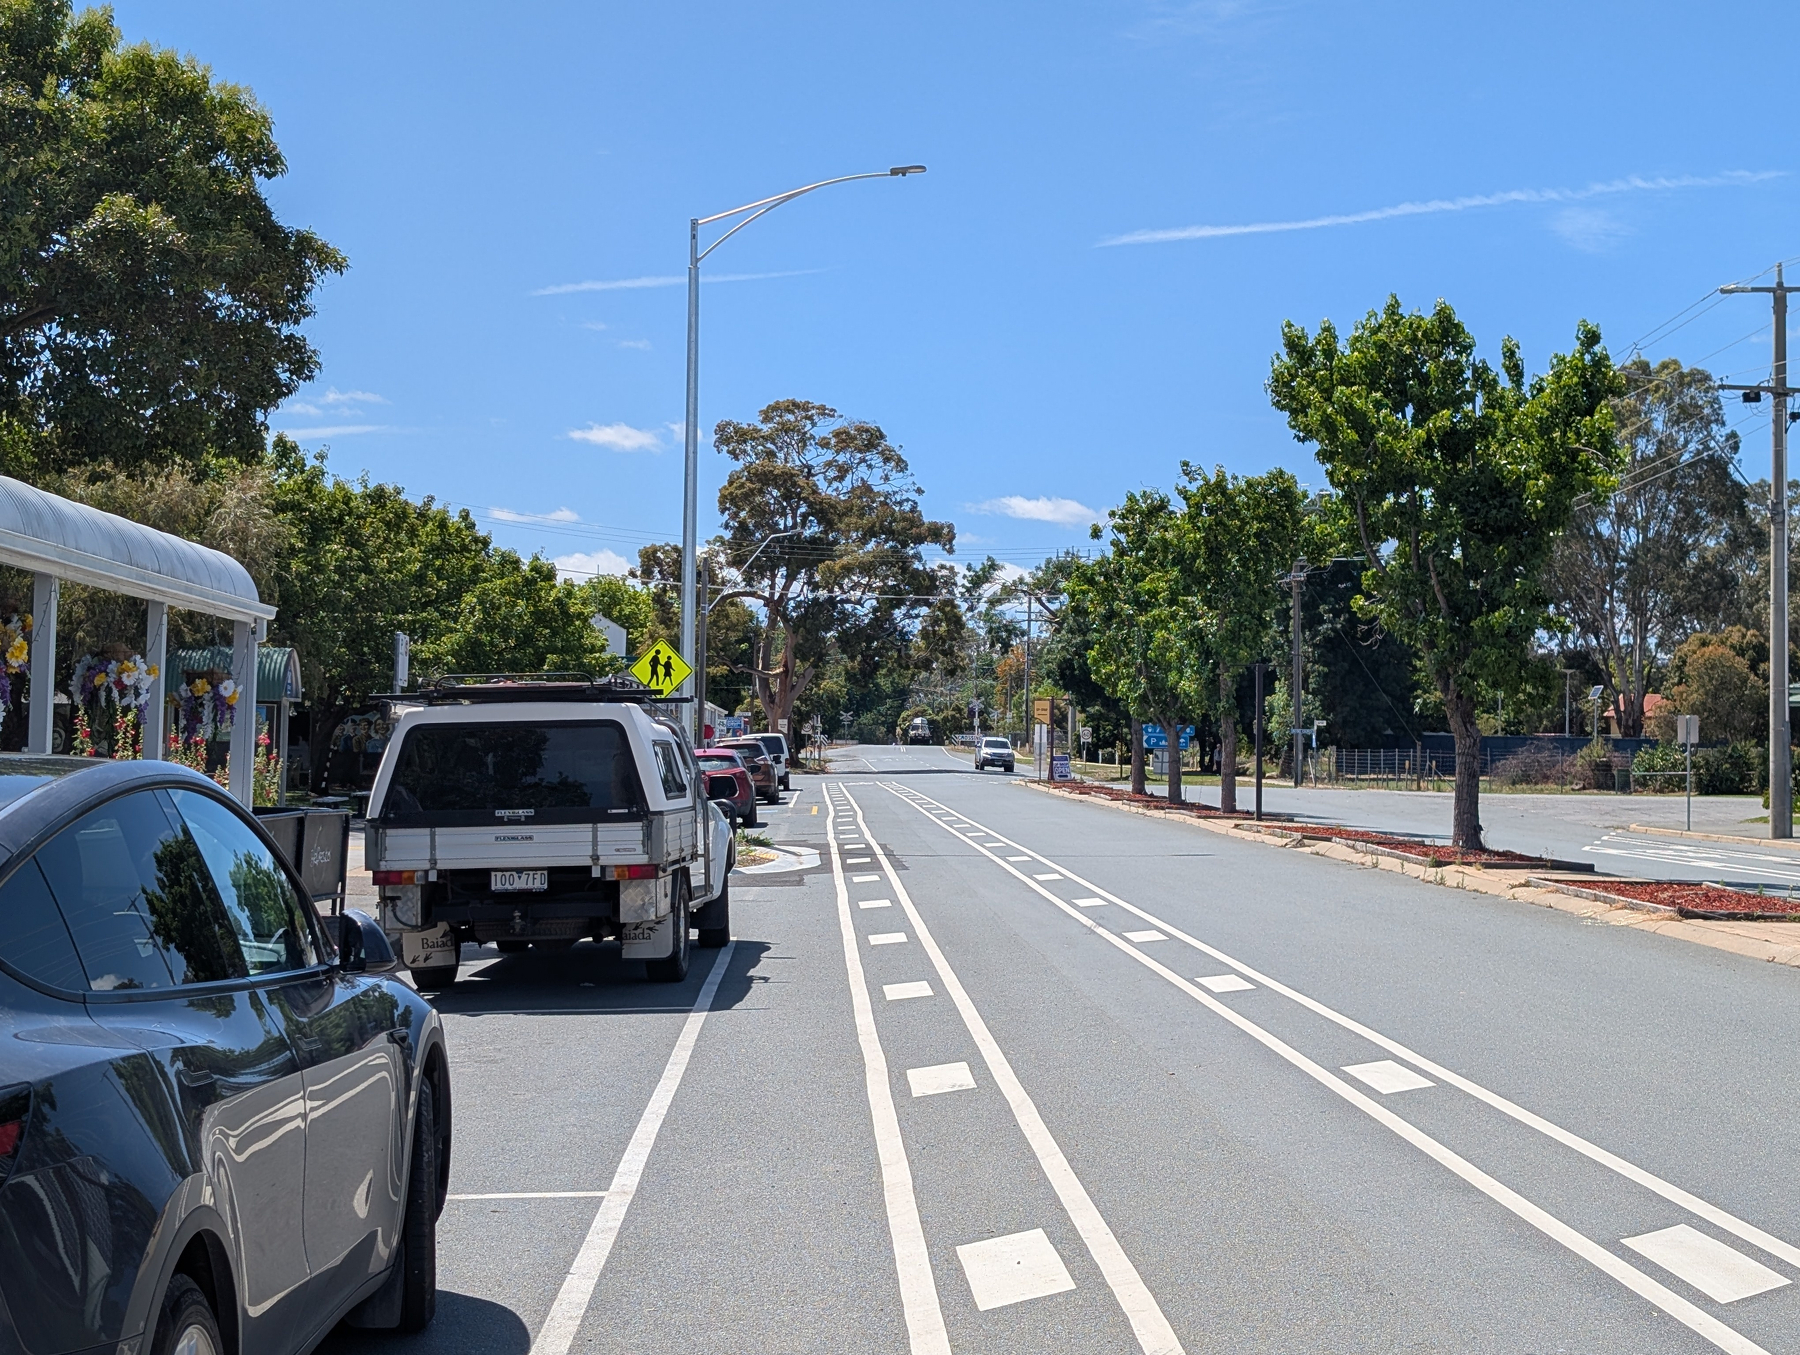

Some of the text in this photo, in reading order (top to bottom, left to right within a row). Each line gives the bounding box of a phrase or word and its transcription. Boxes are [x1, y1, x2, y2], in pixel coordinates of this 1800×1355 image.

[1150, 737, 1157, 745] P
[493, 872, 546, 886] 100 7FD
[622, 928, 652, 940] aiada
[421, 937, 453, 949] Baiad
